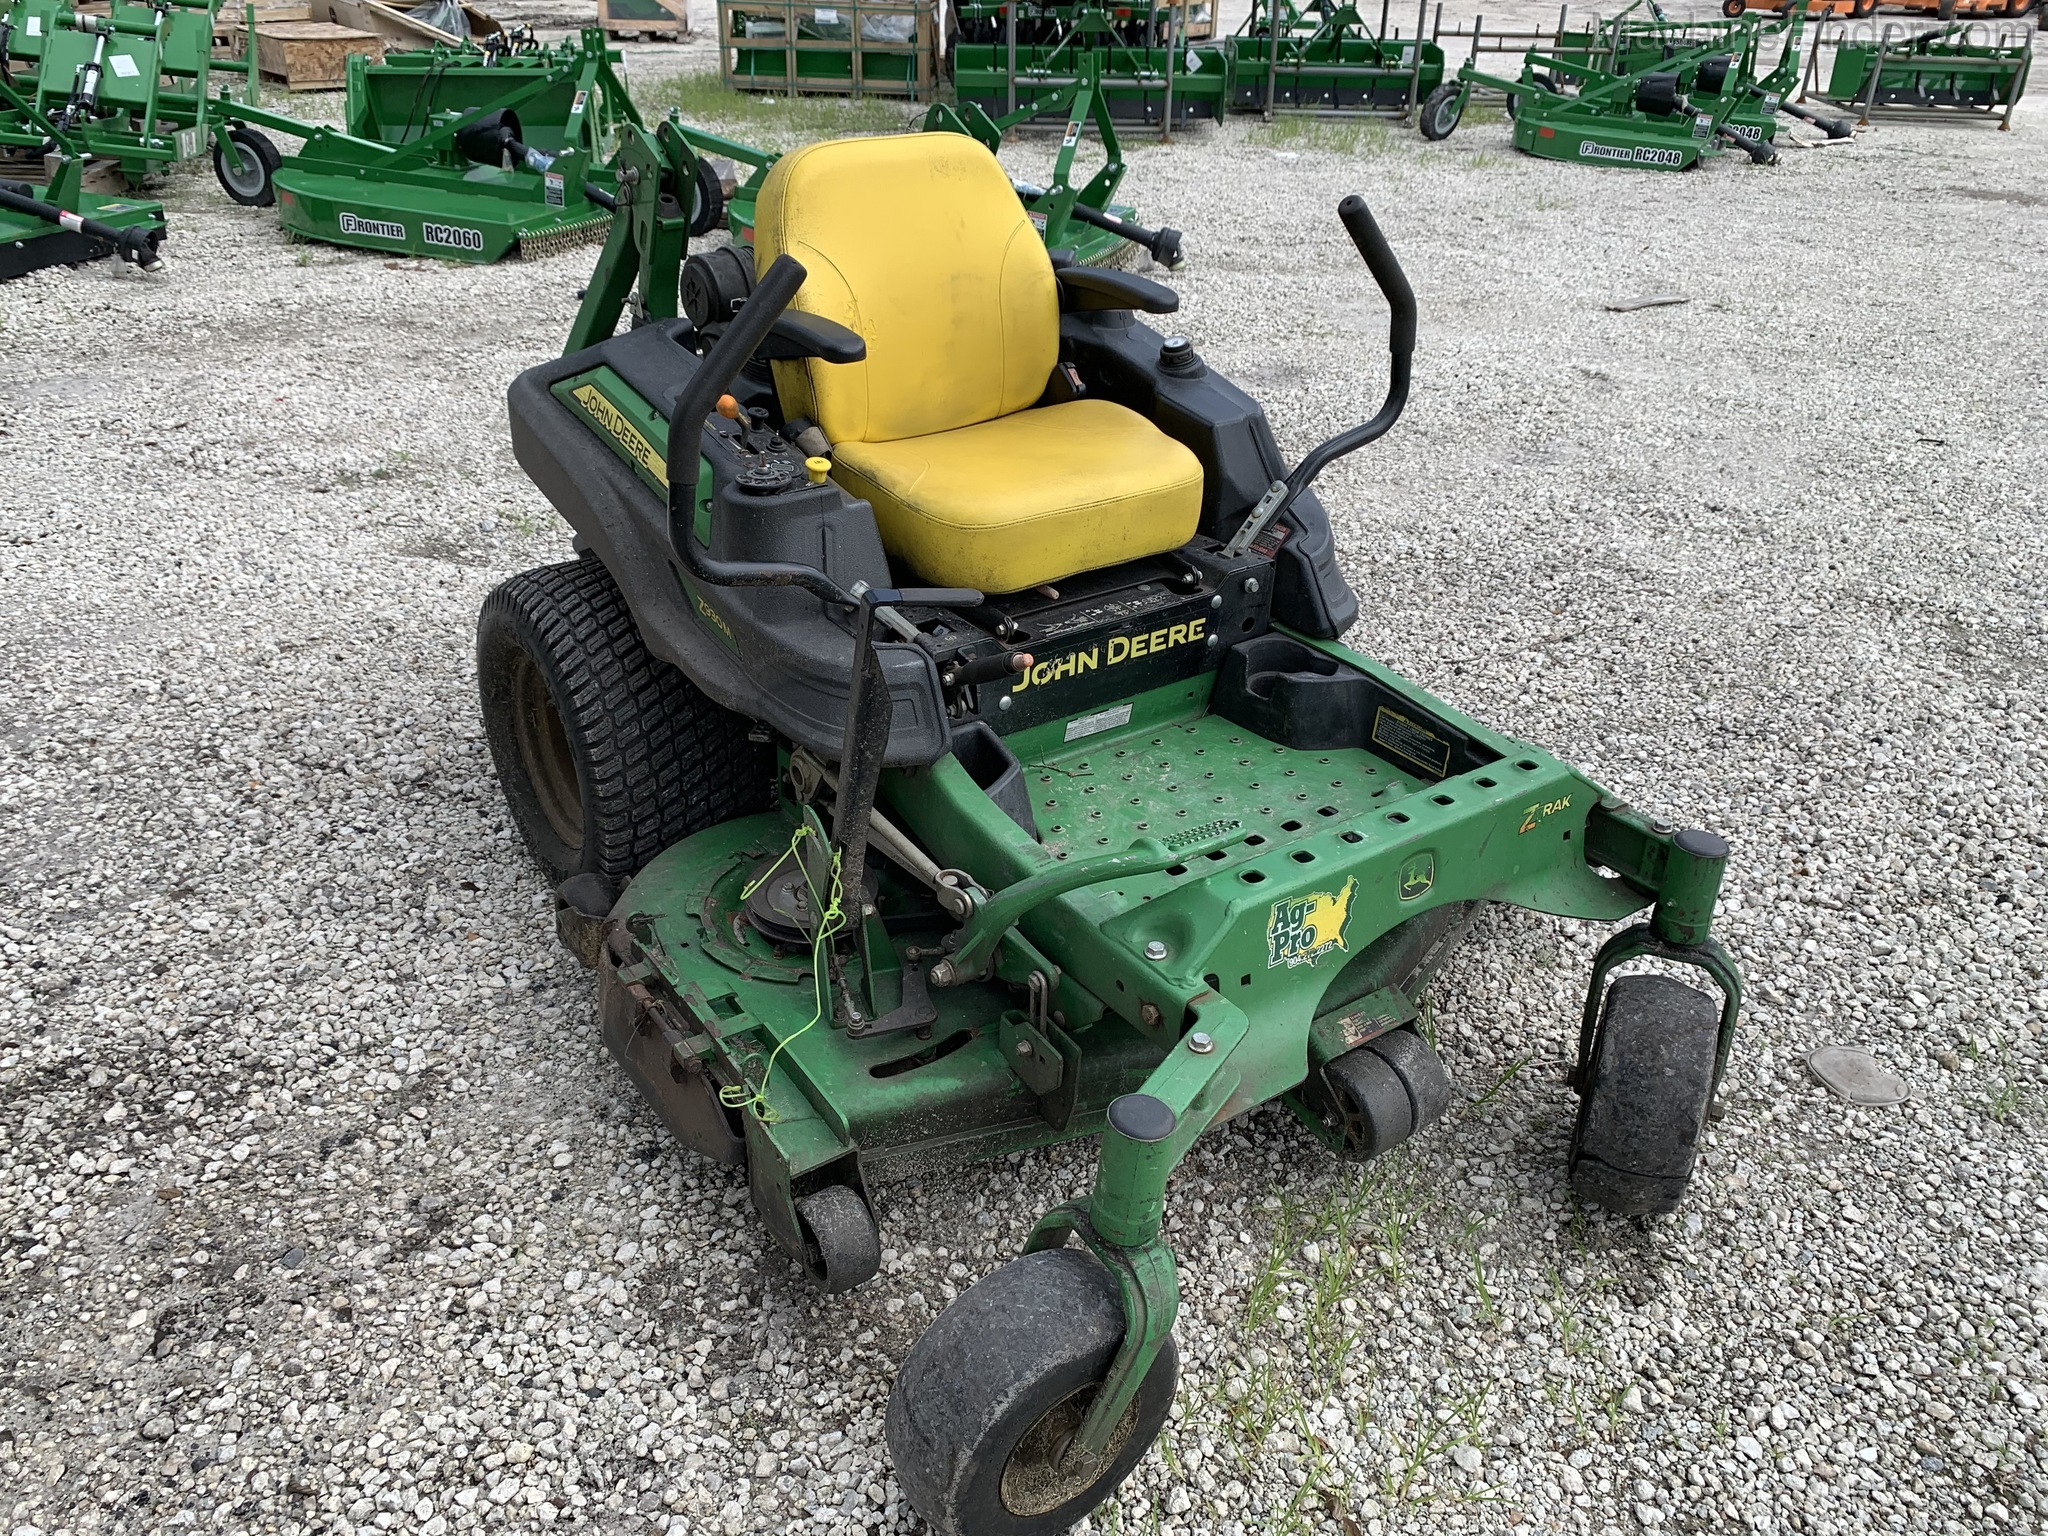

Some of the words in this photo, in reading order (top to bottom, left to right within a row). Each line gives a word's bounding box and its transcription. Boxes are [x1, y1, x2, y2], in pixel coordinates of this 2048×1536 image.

[1581, 142, 1632, 160] FRONTIER
[1634, 146, 1682, 166] RC2048
[341, 214, 404, 238] FRONTIER
[424, 224, 482, 250] RC2060
[582, 389, 614, 431] JOHN
[612, 414, 652, 467] DEERE
[696, 594, 733, 640] Z930M
[1012, 648, 1099, 693] JOHN
[1107, 617, 1207, 666] DEERE
[1271, 899, 1317, 936] Ag-
[1270, 925, 1318, 965] Pro
